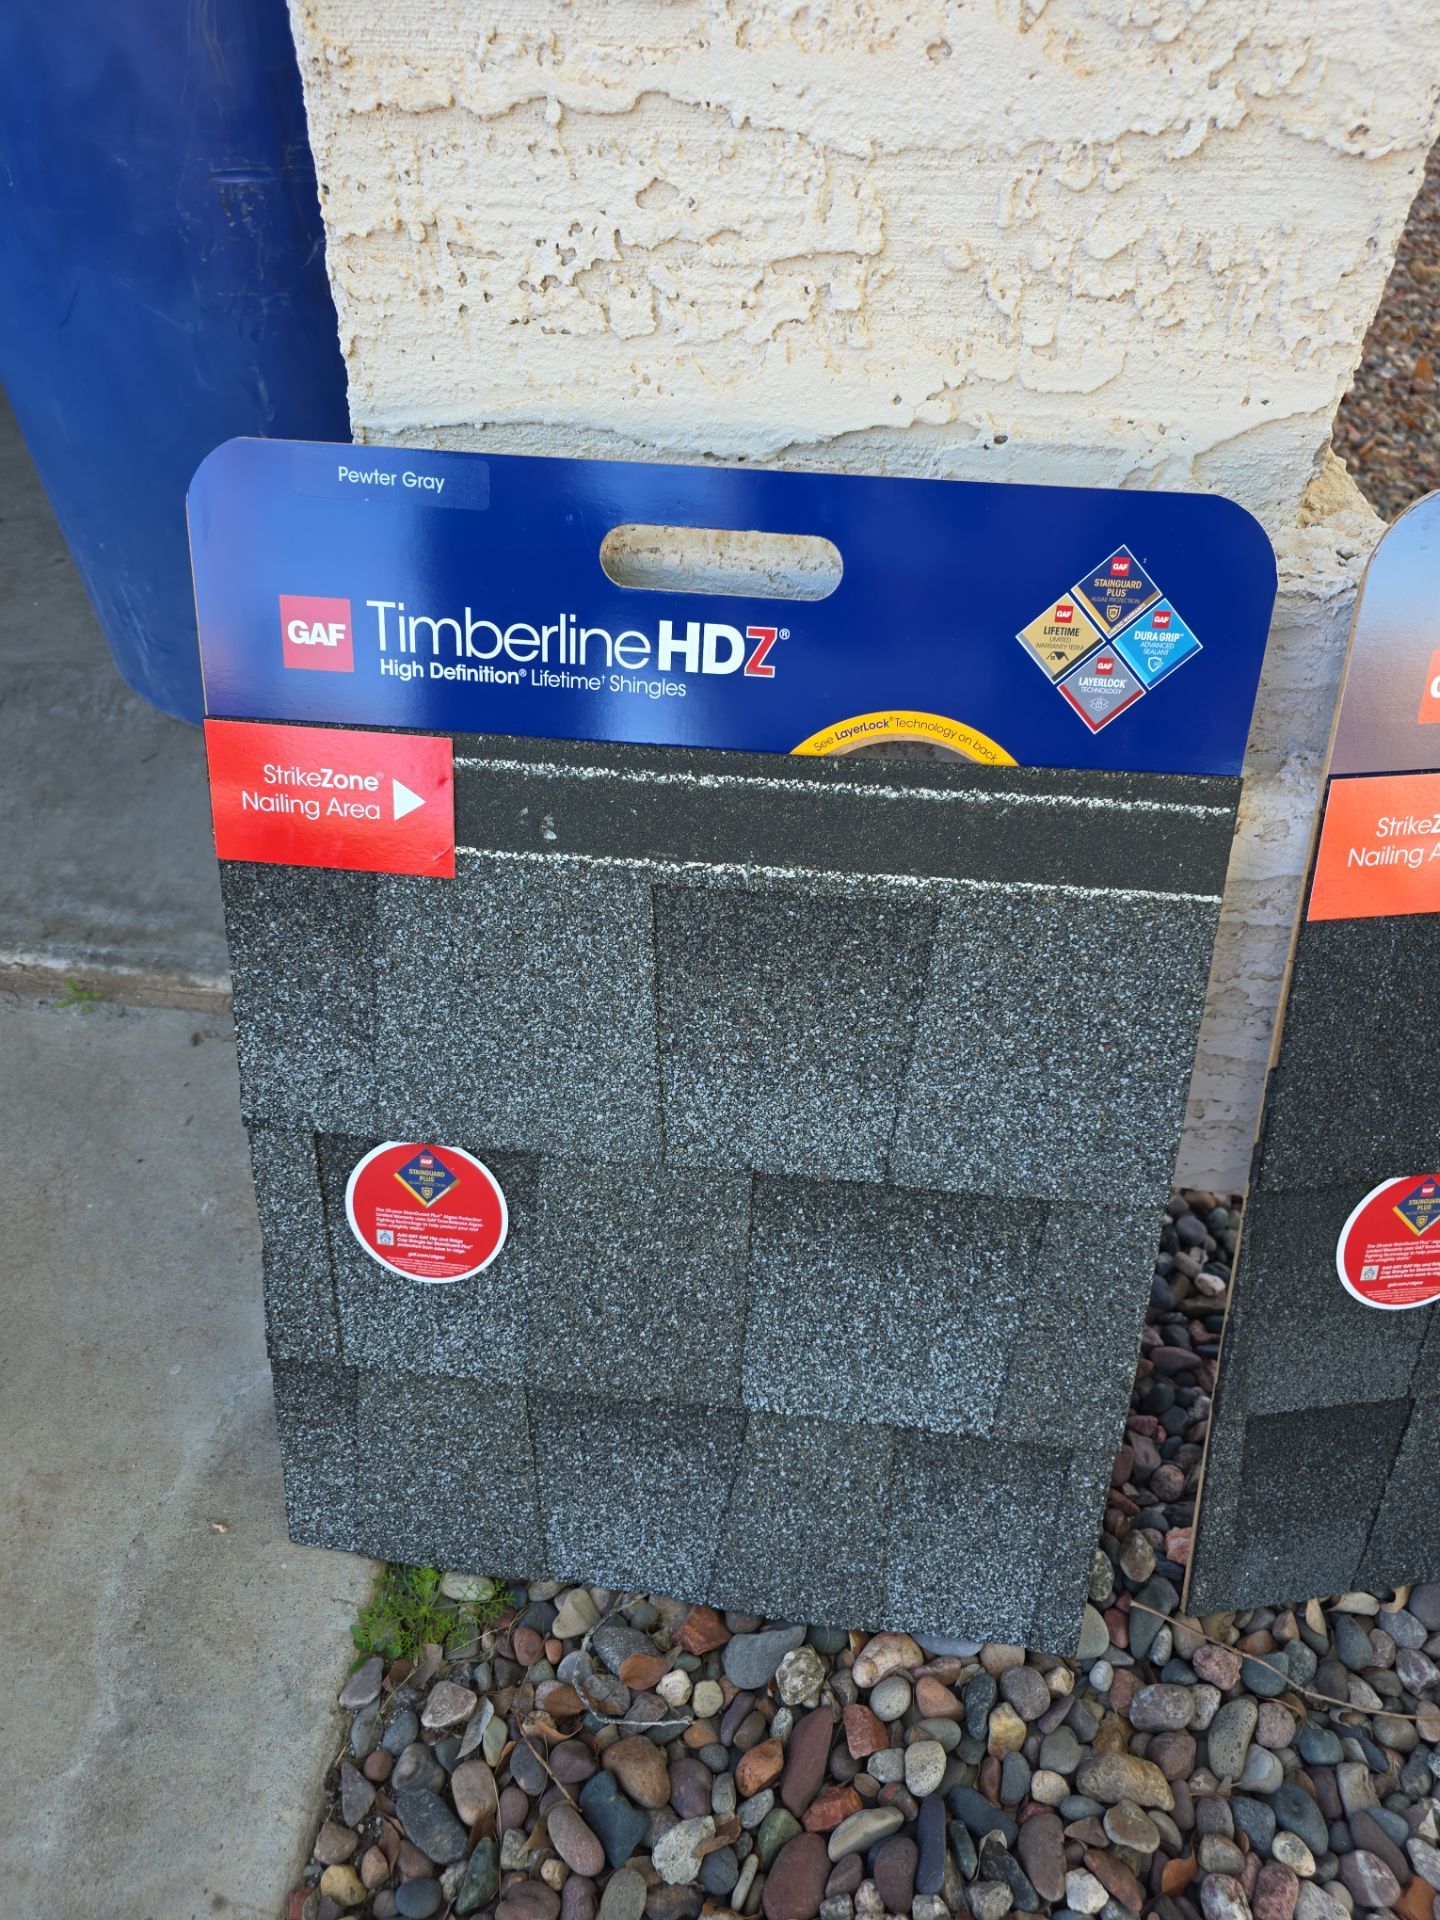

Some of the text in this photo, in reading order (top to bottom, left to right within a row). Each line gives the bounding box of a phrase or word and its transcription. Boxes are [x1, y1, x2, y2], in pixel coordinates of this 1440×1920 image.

[338, 465, 445, 494] Pewter Gray
[1112, 563, 1129, 571] GAF
[1094, 578, 1142, 590] STAINGUARD
[1056, 610, 1072, 618] GAF
[1154, 615, 1170, 624] GAF
[287, 619, 346, 647] GAF
[366, 599, 652, 670] Timberline
[1043, 625, 1081, 637] LIFETIME
[1134, 630, 1158, 641] DURA
[1140, 641, 1175, 650] ADVANCED
[1143, 648, 1170, 656] SEALANT
[1097, 662, 1112, 670] GAF
[380, 658, 425, 683] High
[610, 675, 687, 700] Shingles
[1081, 686, 1123, 696] TECHNOLOGY
[813, 735, 834, 752] See
[895, 717, 957, 739] Technology
[958, 732, 972, 747] on
[972, 739, 998, 763] back
[242, 791, 381, 821] Nailing Area
[1347, 846, 1423, 869] Nailing
